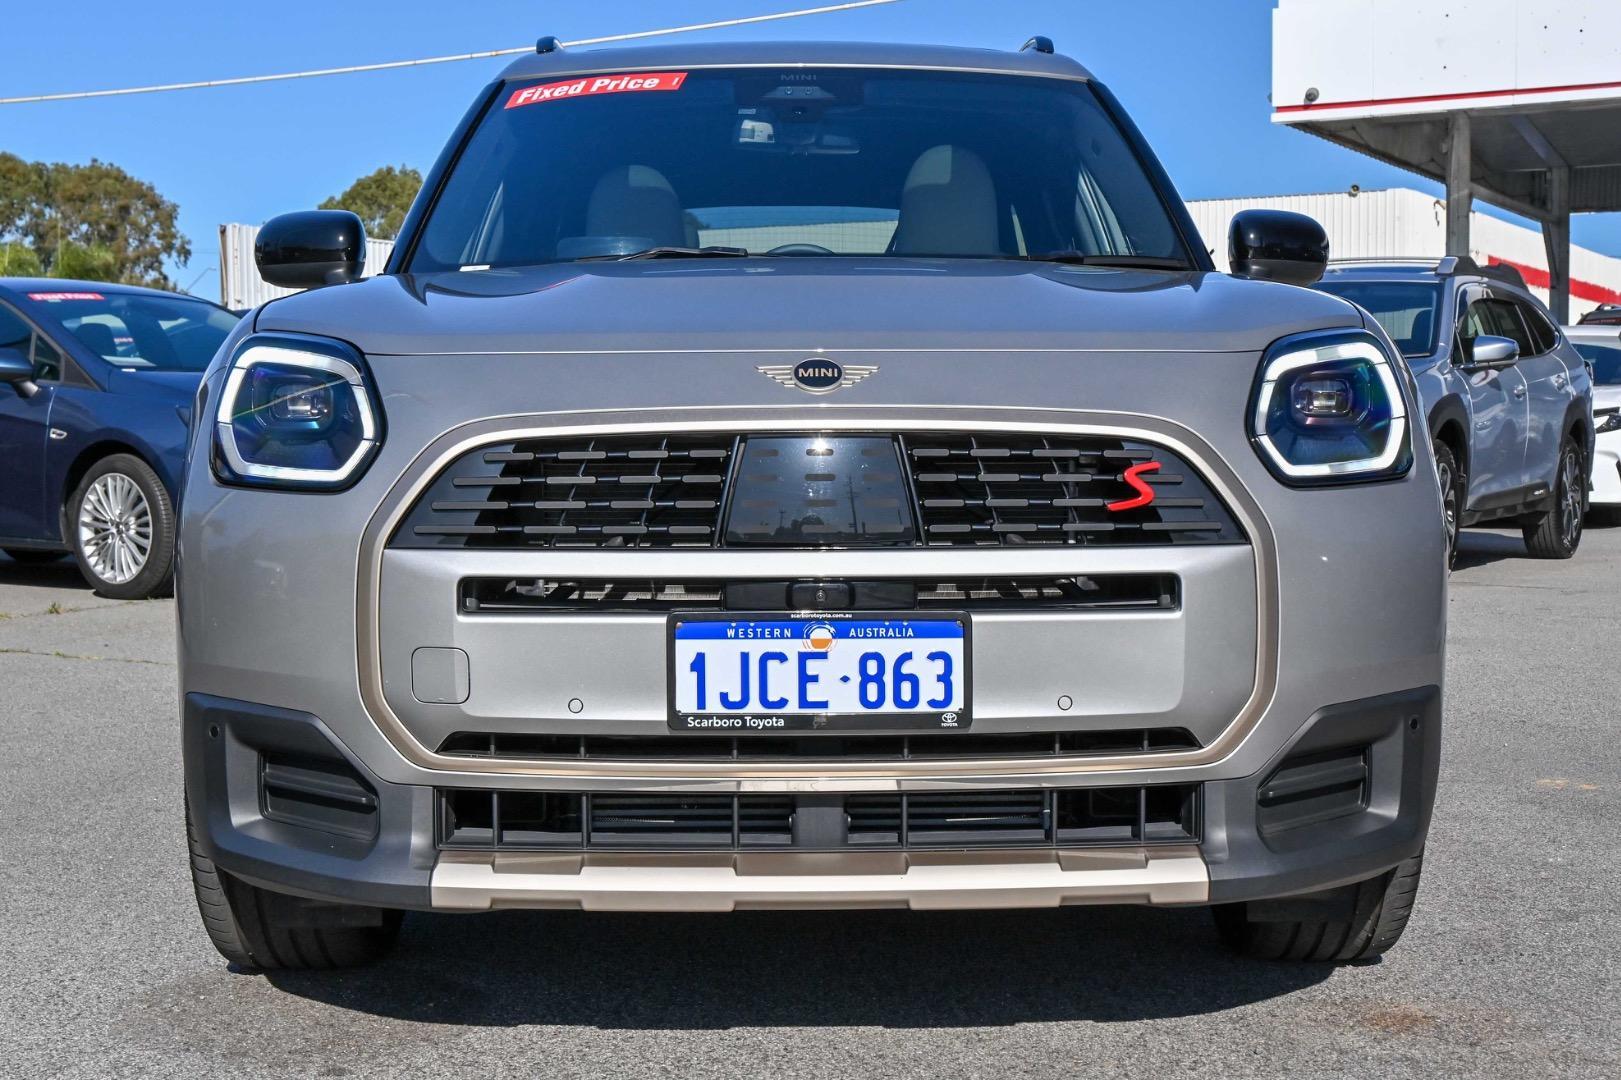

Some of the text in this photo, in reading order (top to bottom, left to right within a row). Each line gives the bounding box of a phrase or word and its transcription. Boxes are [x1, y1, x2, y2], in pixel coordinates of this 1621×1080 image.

[516, 77, 660, 104] Fixed Price
[798, 368, 838, 378] MINI
[1107, 461, 1162, 512] S
[727, 628, 914, 638] WESTERN AUSTRALIA
[687, 716, 785, 728] Scarboro Toyota
